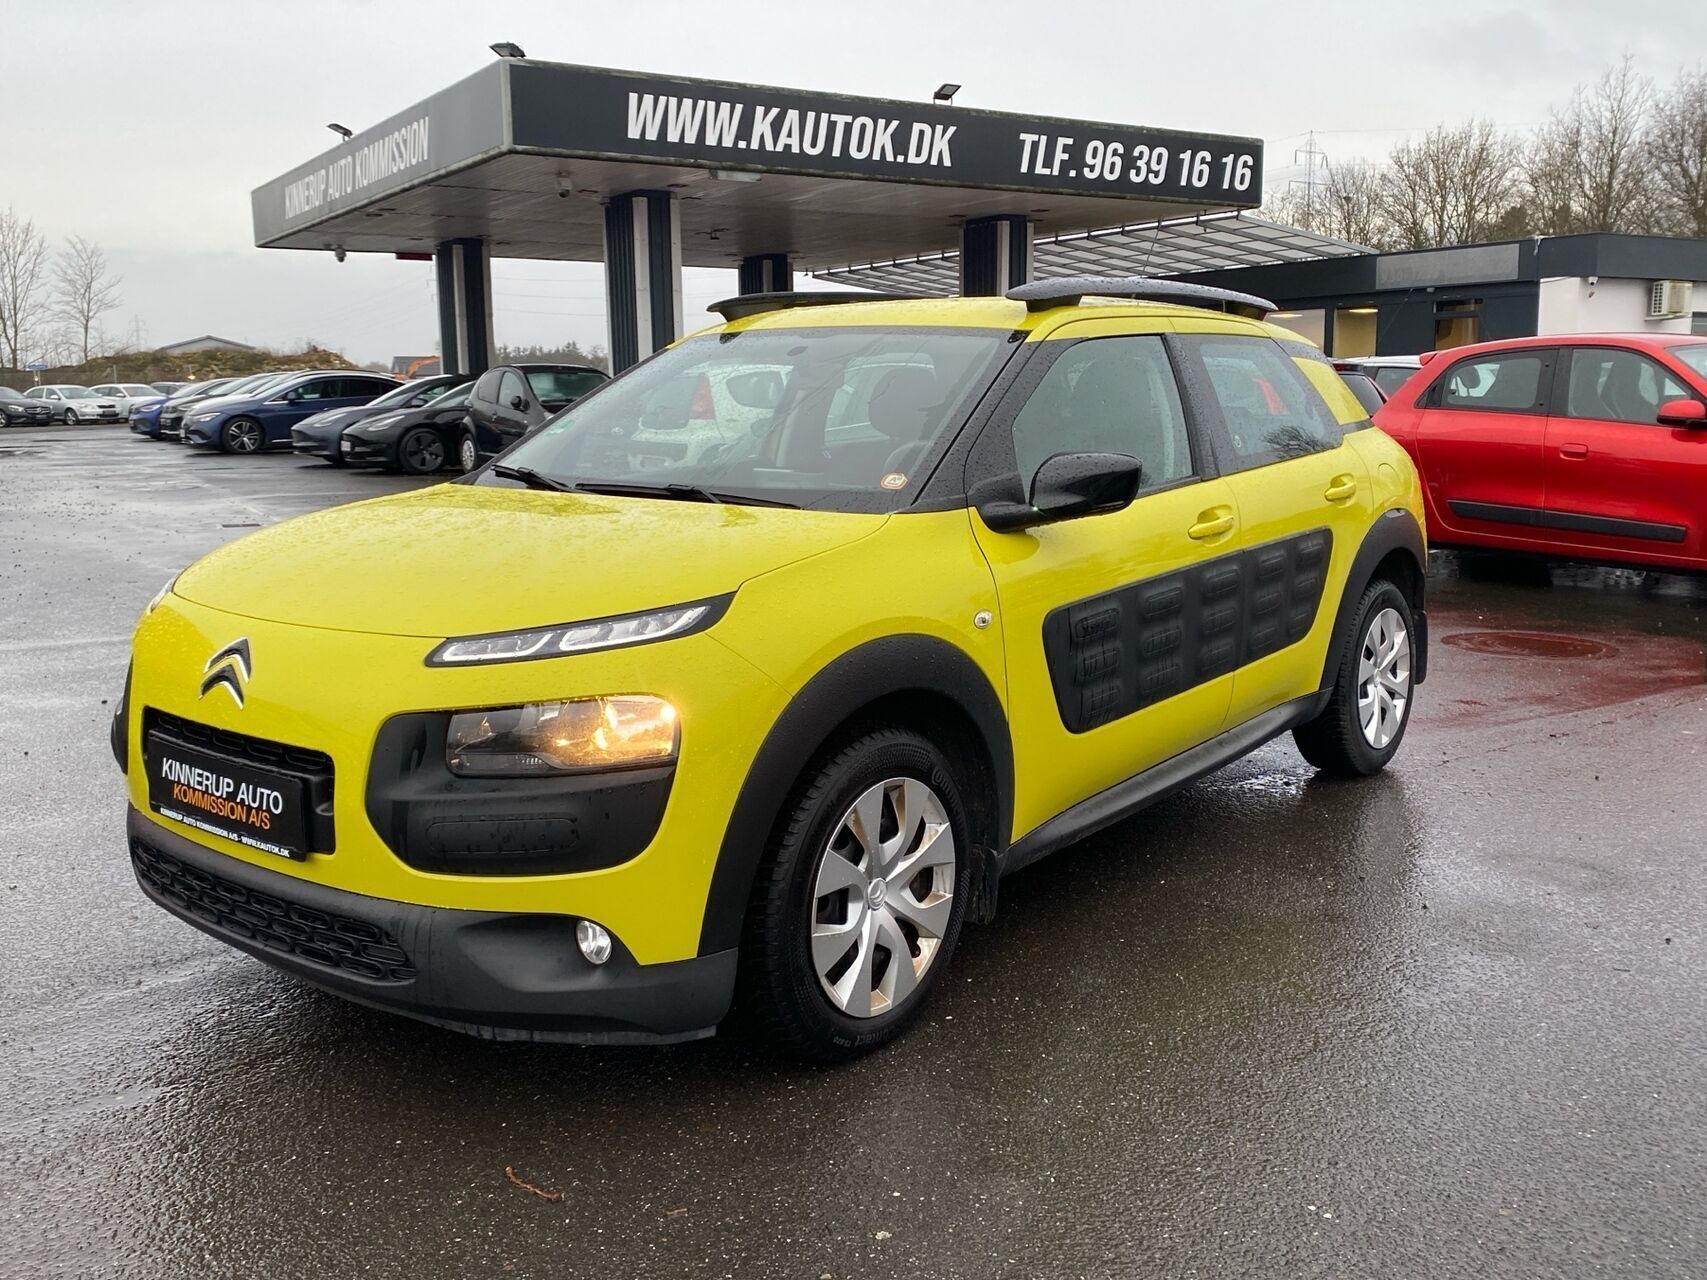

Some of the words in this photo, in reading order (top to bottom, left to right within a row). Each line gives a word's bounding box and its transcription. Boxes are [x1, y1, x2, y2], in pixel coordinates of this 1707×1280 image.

[627, 92, 958, 167] WWW.KAUTOK.DK
[285, 168, 327, 220] KINNERUP
[327, 155, 353, 202] AUTO
[355, 116, 429, 190] KOMMISSION
[1019, 132, 1078, 178] TLF.
[1083, 139, 1125, 181] 96
[1130, 144, 1169, 185] 39
[1179, 149, 1212, 188] 16
[1221, 153, 1254, 191] 16
[162, 757, 234, 798] KINNERUP
[236, 782, 283, 815] AUTO
[173, 783, 247, 823] KOMMISSION
[249, 808, 271, 829] A/S
